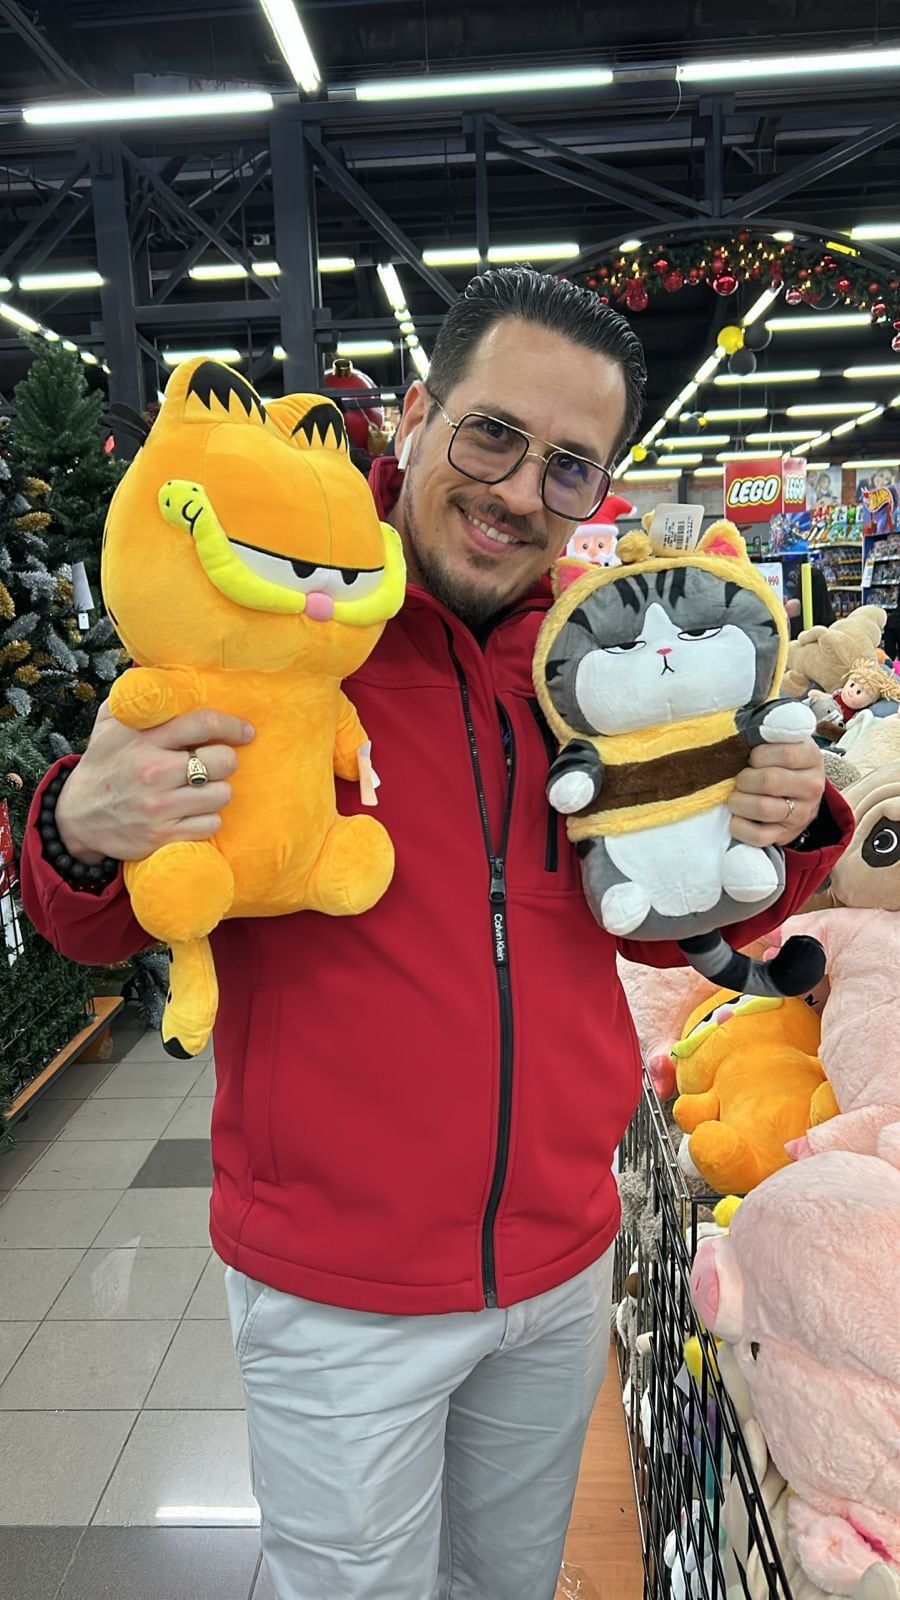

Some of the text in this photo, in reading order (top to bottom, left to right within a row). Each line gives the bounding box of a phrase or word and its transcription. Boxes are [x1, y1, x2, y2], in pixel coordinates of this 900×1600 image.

[728, 477, 780, 506] LEGO
[494, 913, 505, 961] Calvin Klein
